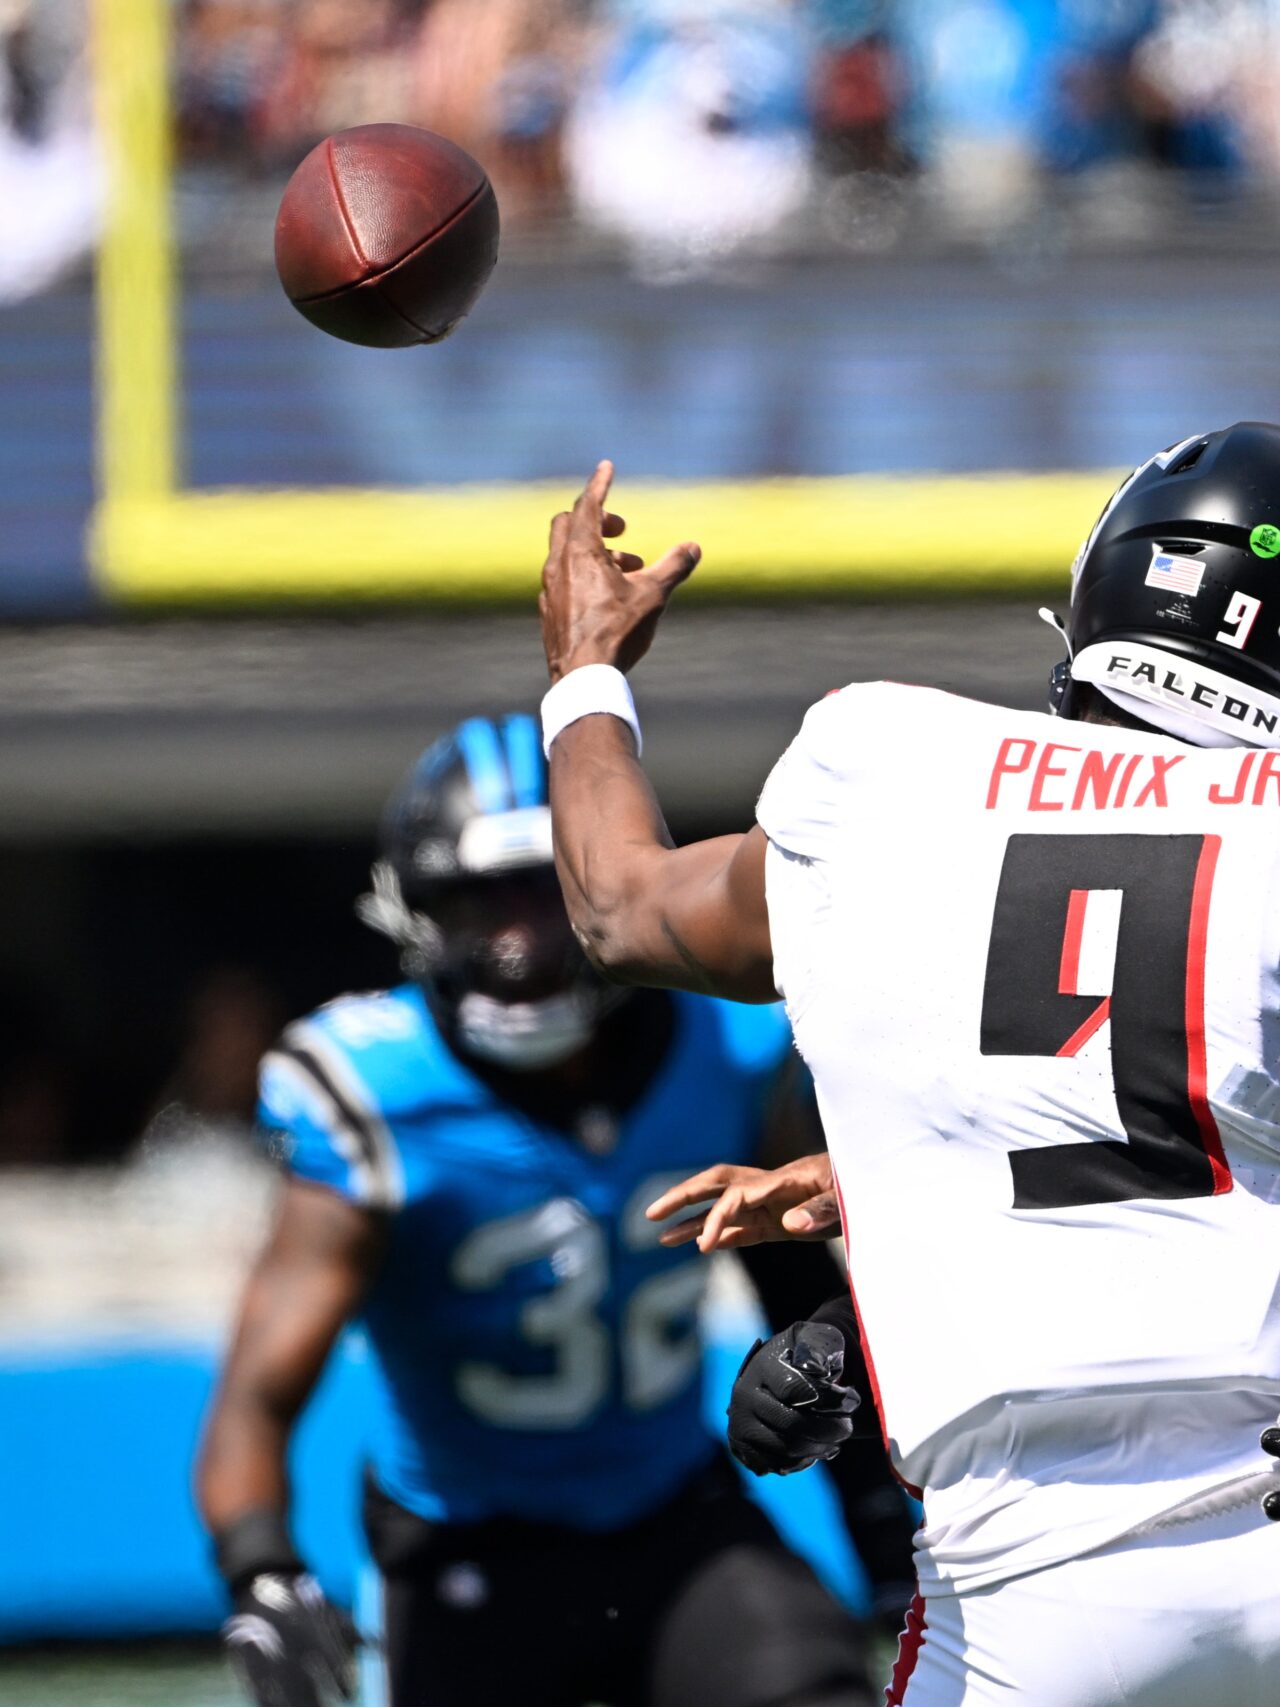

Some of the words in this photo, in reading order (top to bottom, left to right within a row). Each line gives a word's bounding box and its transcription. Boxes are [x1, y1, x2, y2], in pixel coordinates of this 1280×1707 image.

[1216, 590, 1262, 651] 9
[985, 737, 1186, 812] PENIX
[980, 833, 1234, 1210] 9
